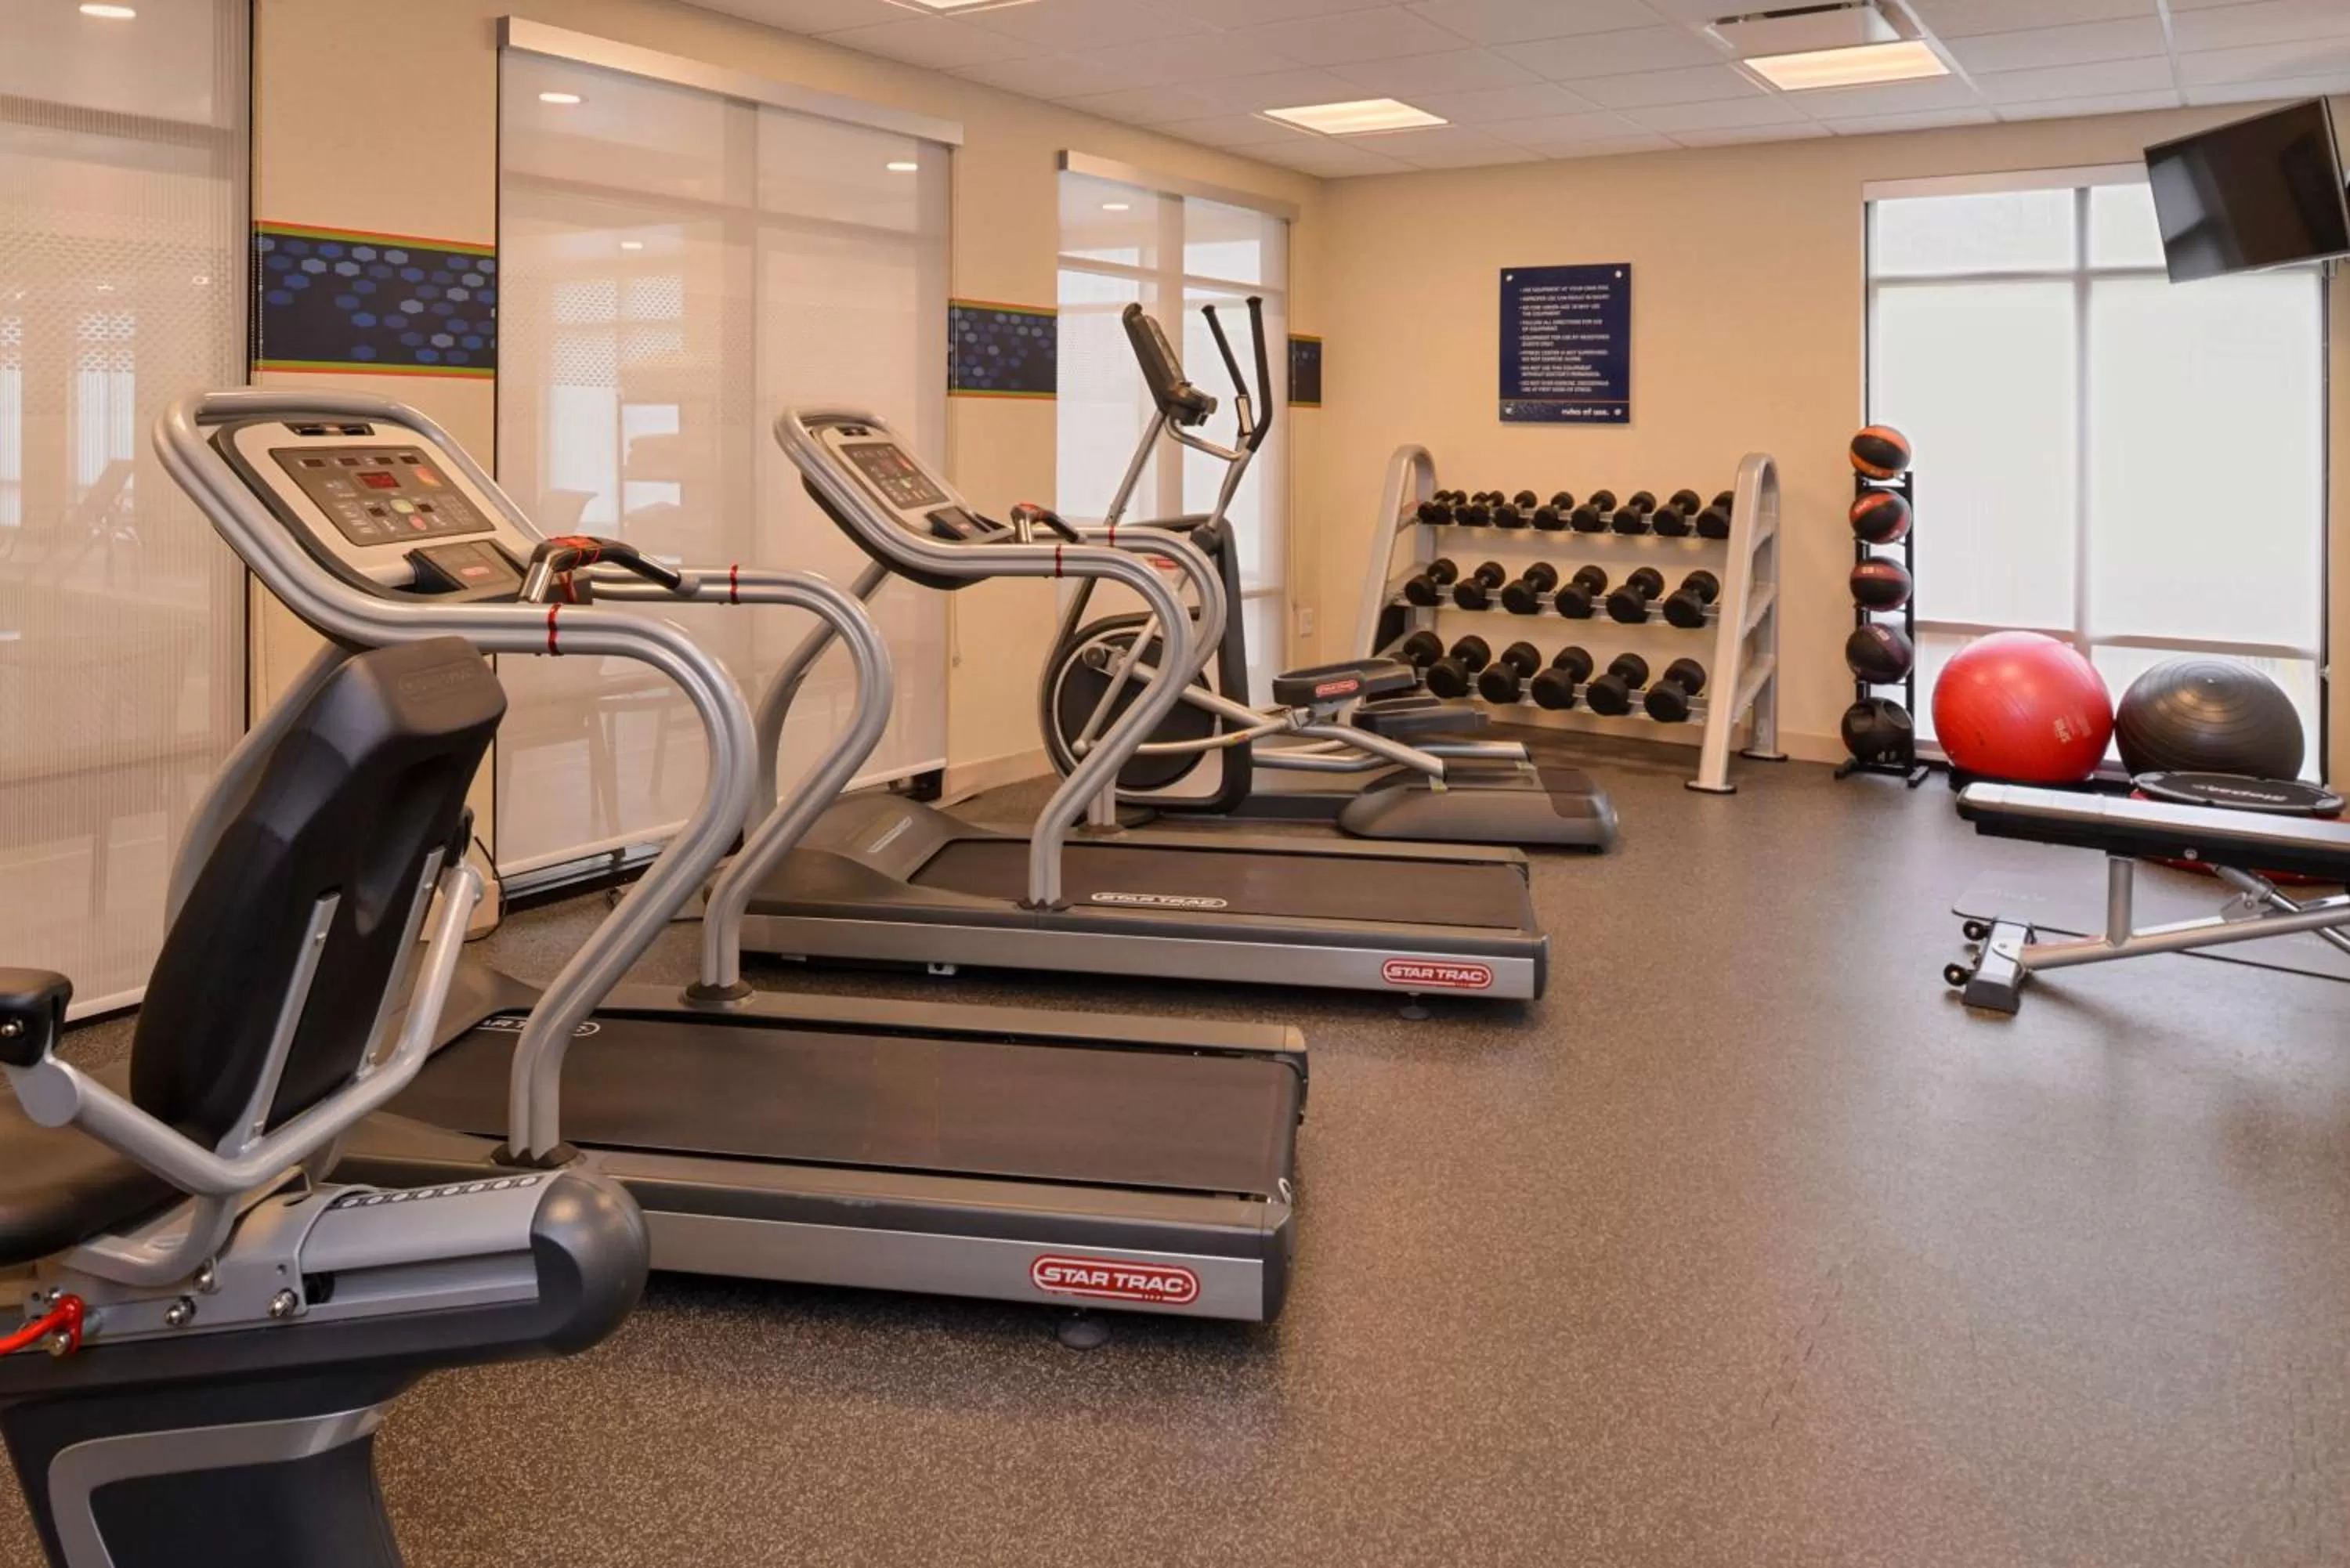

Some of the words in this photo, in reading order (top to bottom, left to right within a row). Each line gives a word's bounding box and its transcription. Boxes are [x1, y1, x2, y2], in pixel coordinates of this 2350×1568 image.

[1390, 966, 1434, 978] STAR
[1437, 969, 1483, 981] TRAC
[1041, 1266, 1109, 1287] STAR
[1112, 1273, 1184, 1292] TRAC
